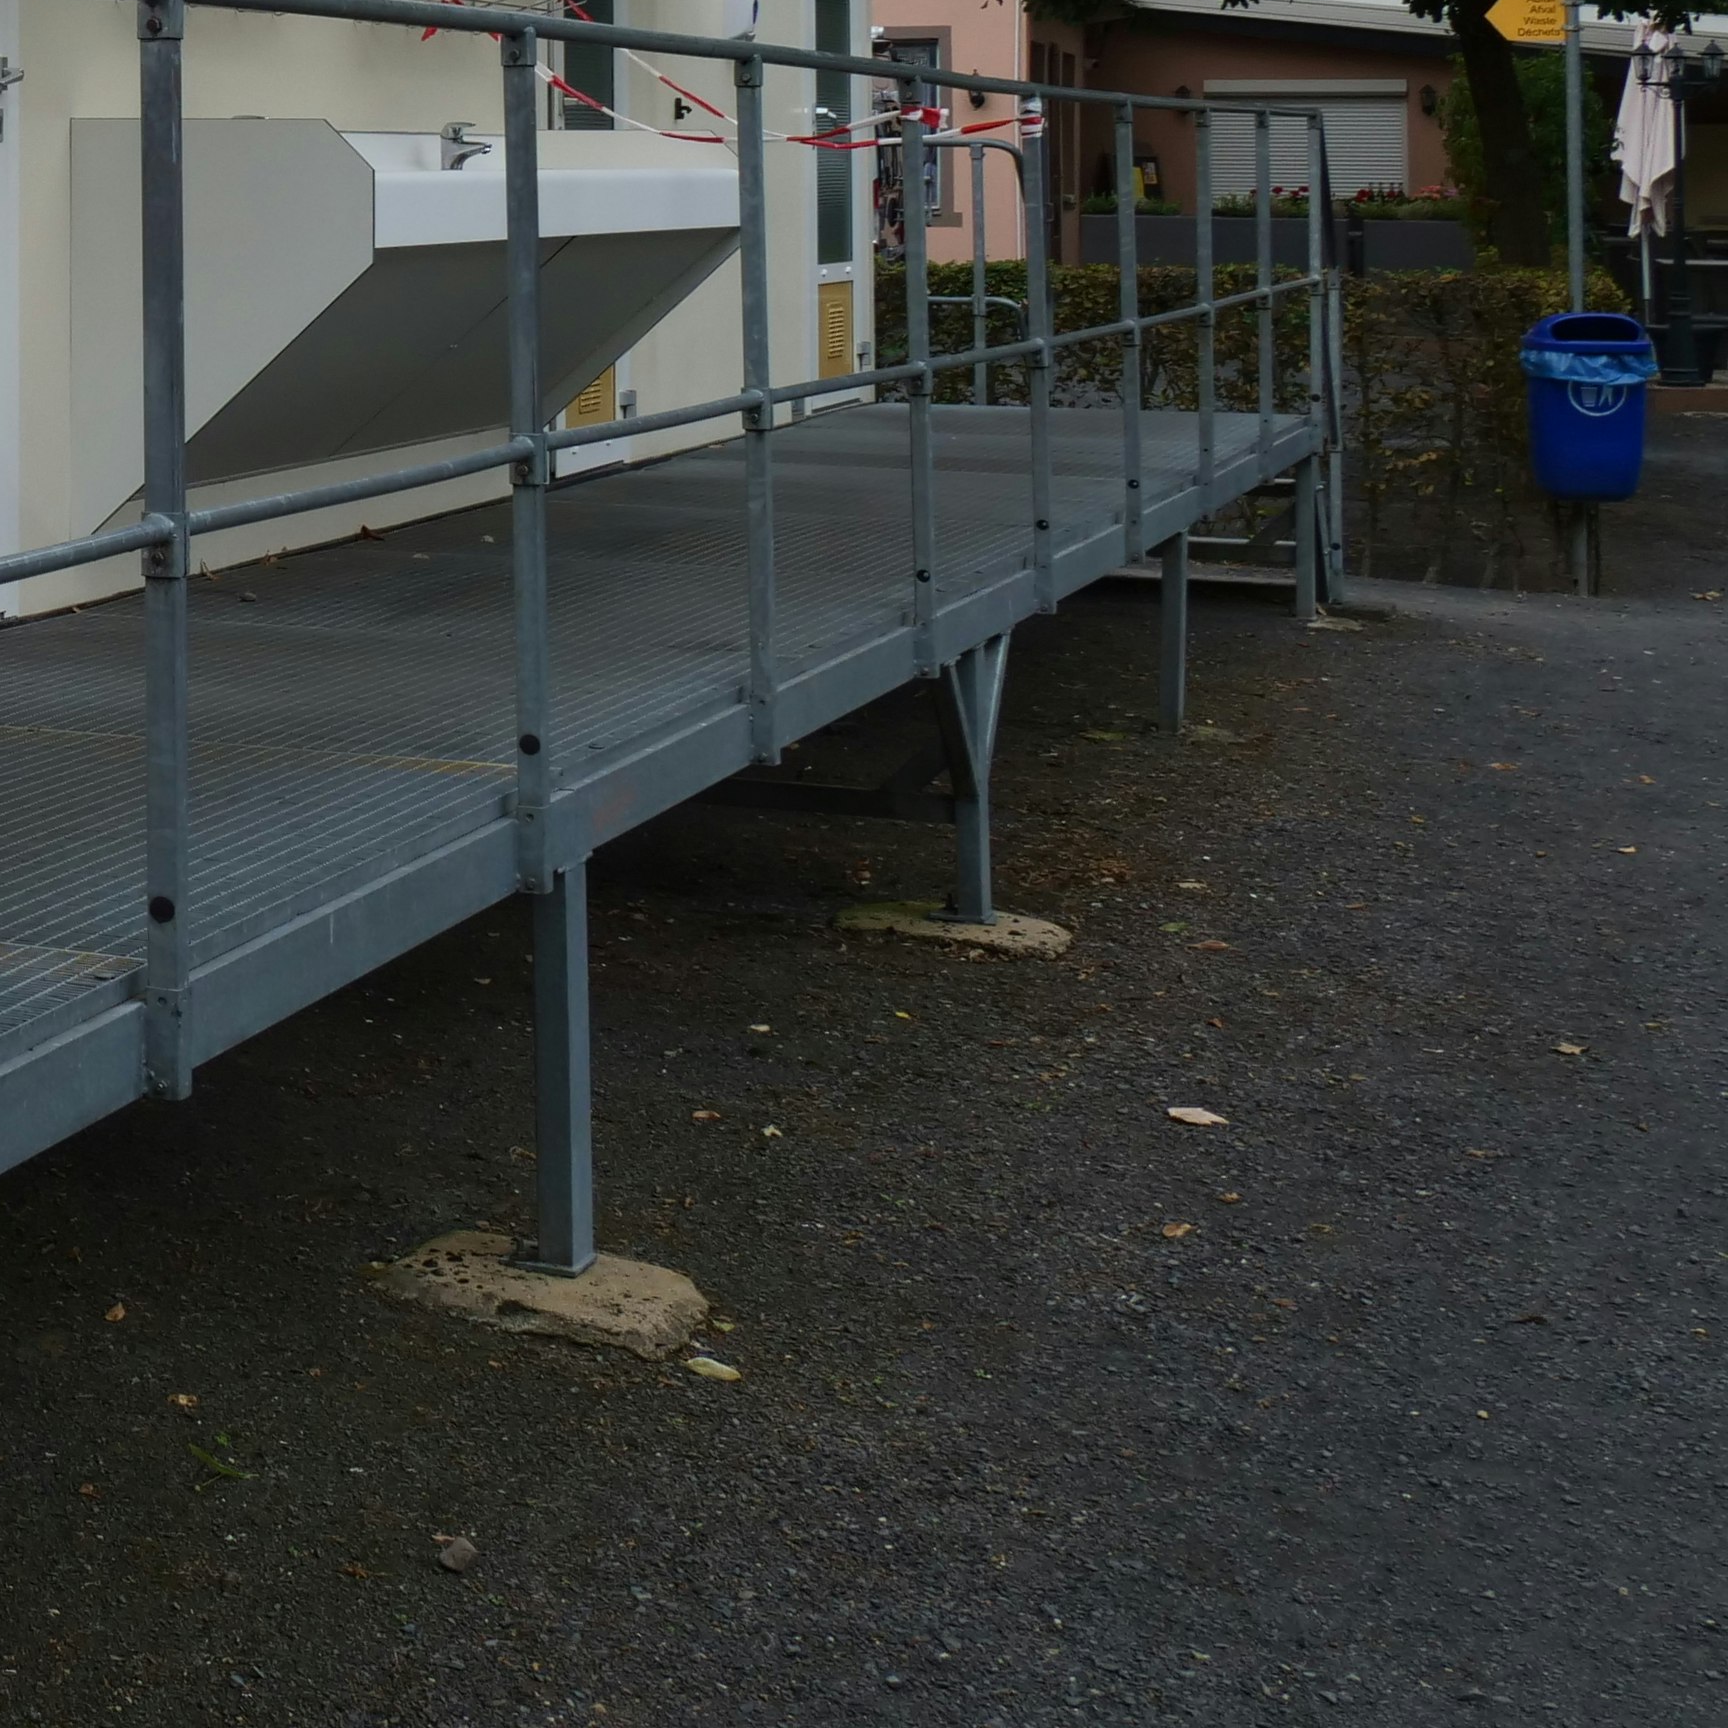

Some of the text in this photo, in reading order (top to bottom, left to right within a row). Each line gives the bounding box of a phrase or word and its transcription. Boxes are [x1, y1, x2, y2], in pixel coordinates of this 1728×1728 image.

[1529, 5, 1556, 13] Afval
[1523, 17, 1557, 25] Waste
[1517, 27, 1560, 37] Déchets
